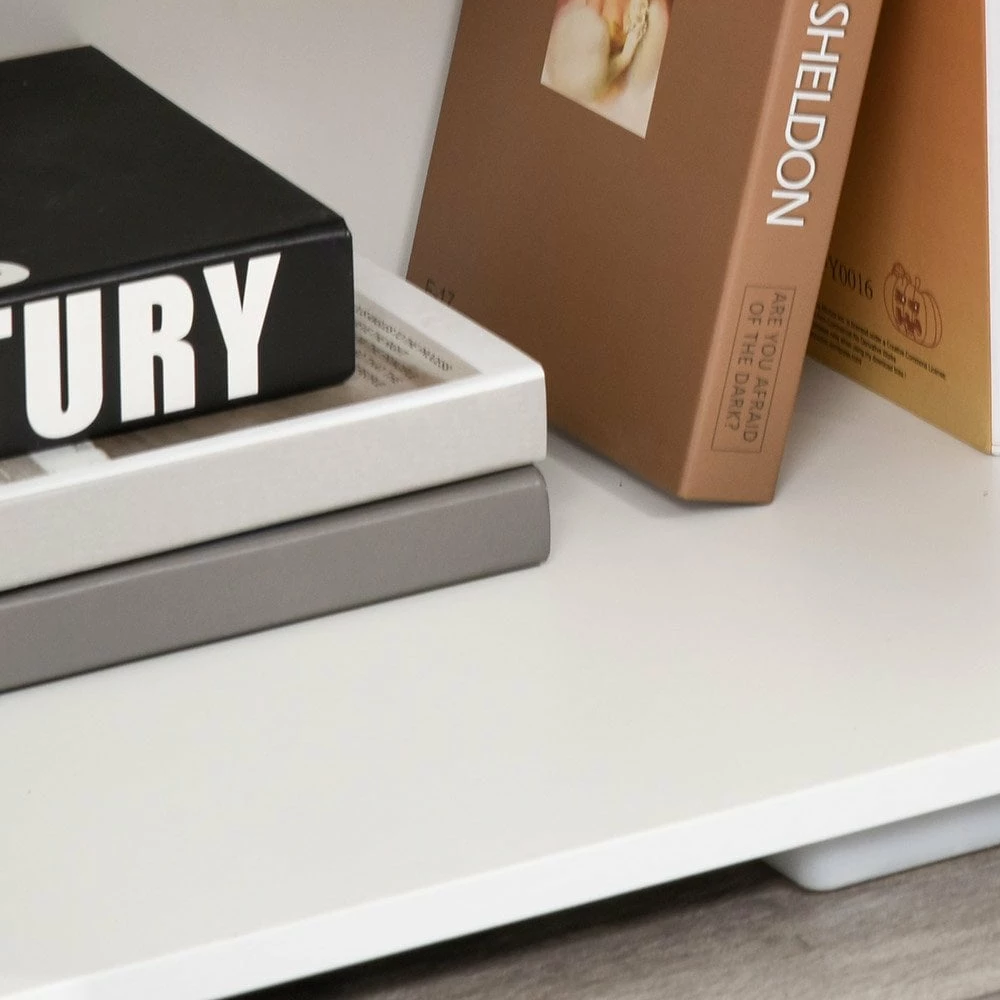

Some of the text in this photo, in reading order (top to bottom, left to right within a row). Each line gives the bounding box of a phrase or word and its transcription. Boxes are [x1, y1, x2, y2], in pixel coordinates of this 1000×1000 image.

[767, 1, 850, 227] SHELDON
[0, 252, 281, 439] URY
[724, 302, 764, 432] OF THE DARK?
[743, 292, 787, 443] ARE YOU AFRAID
